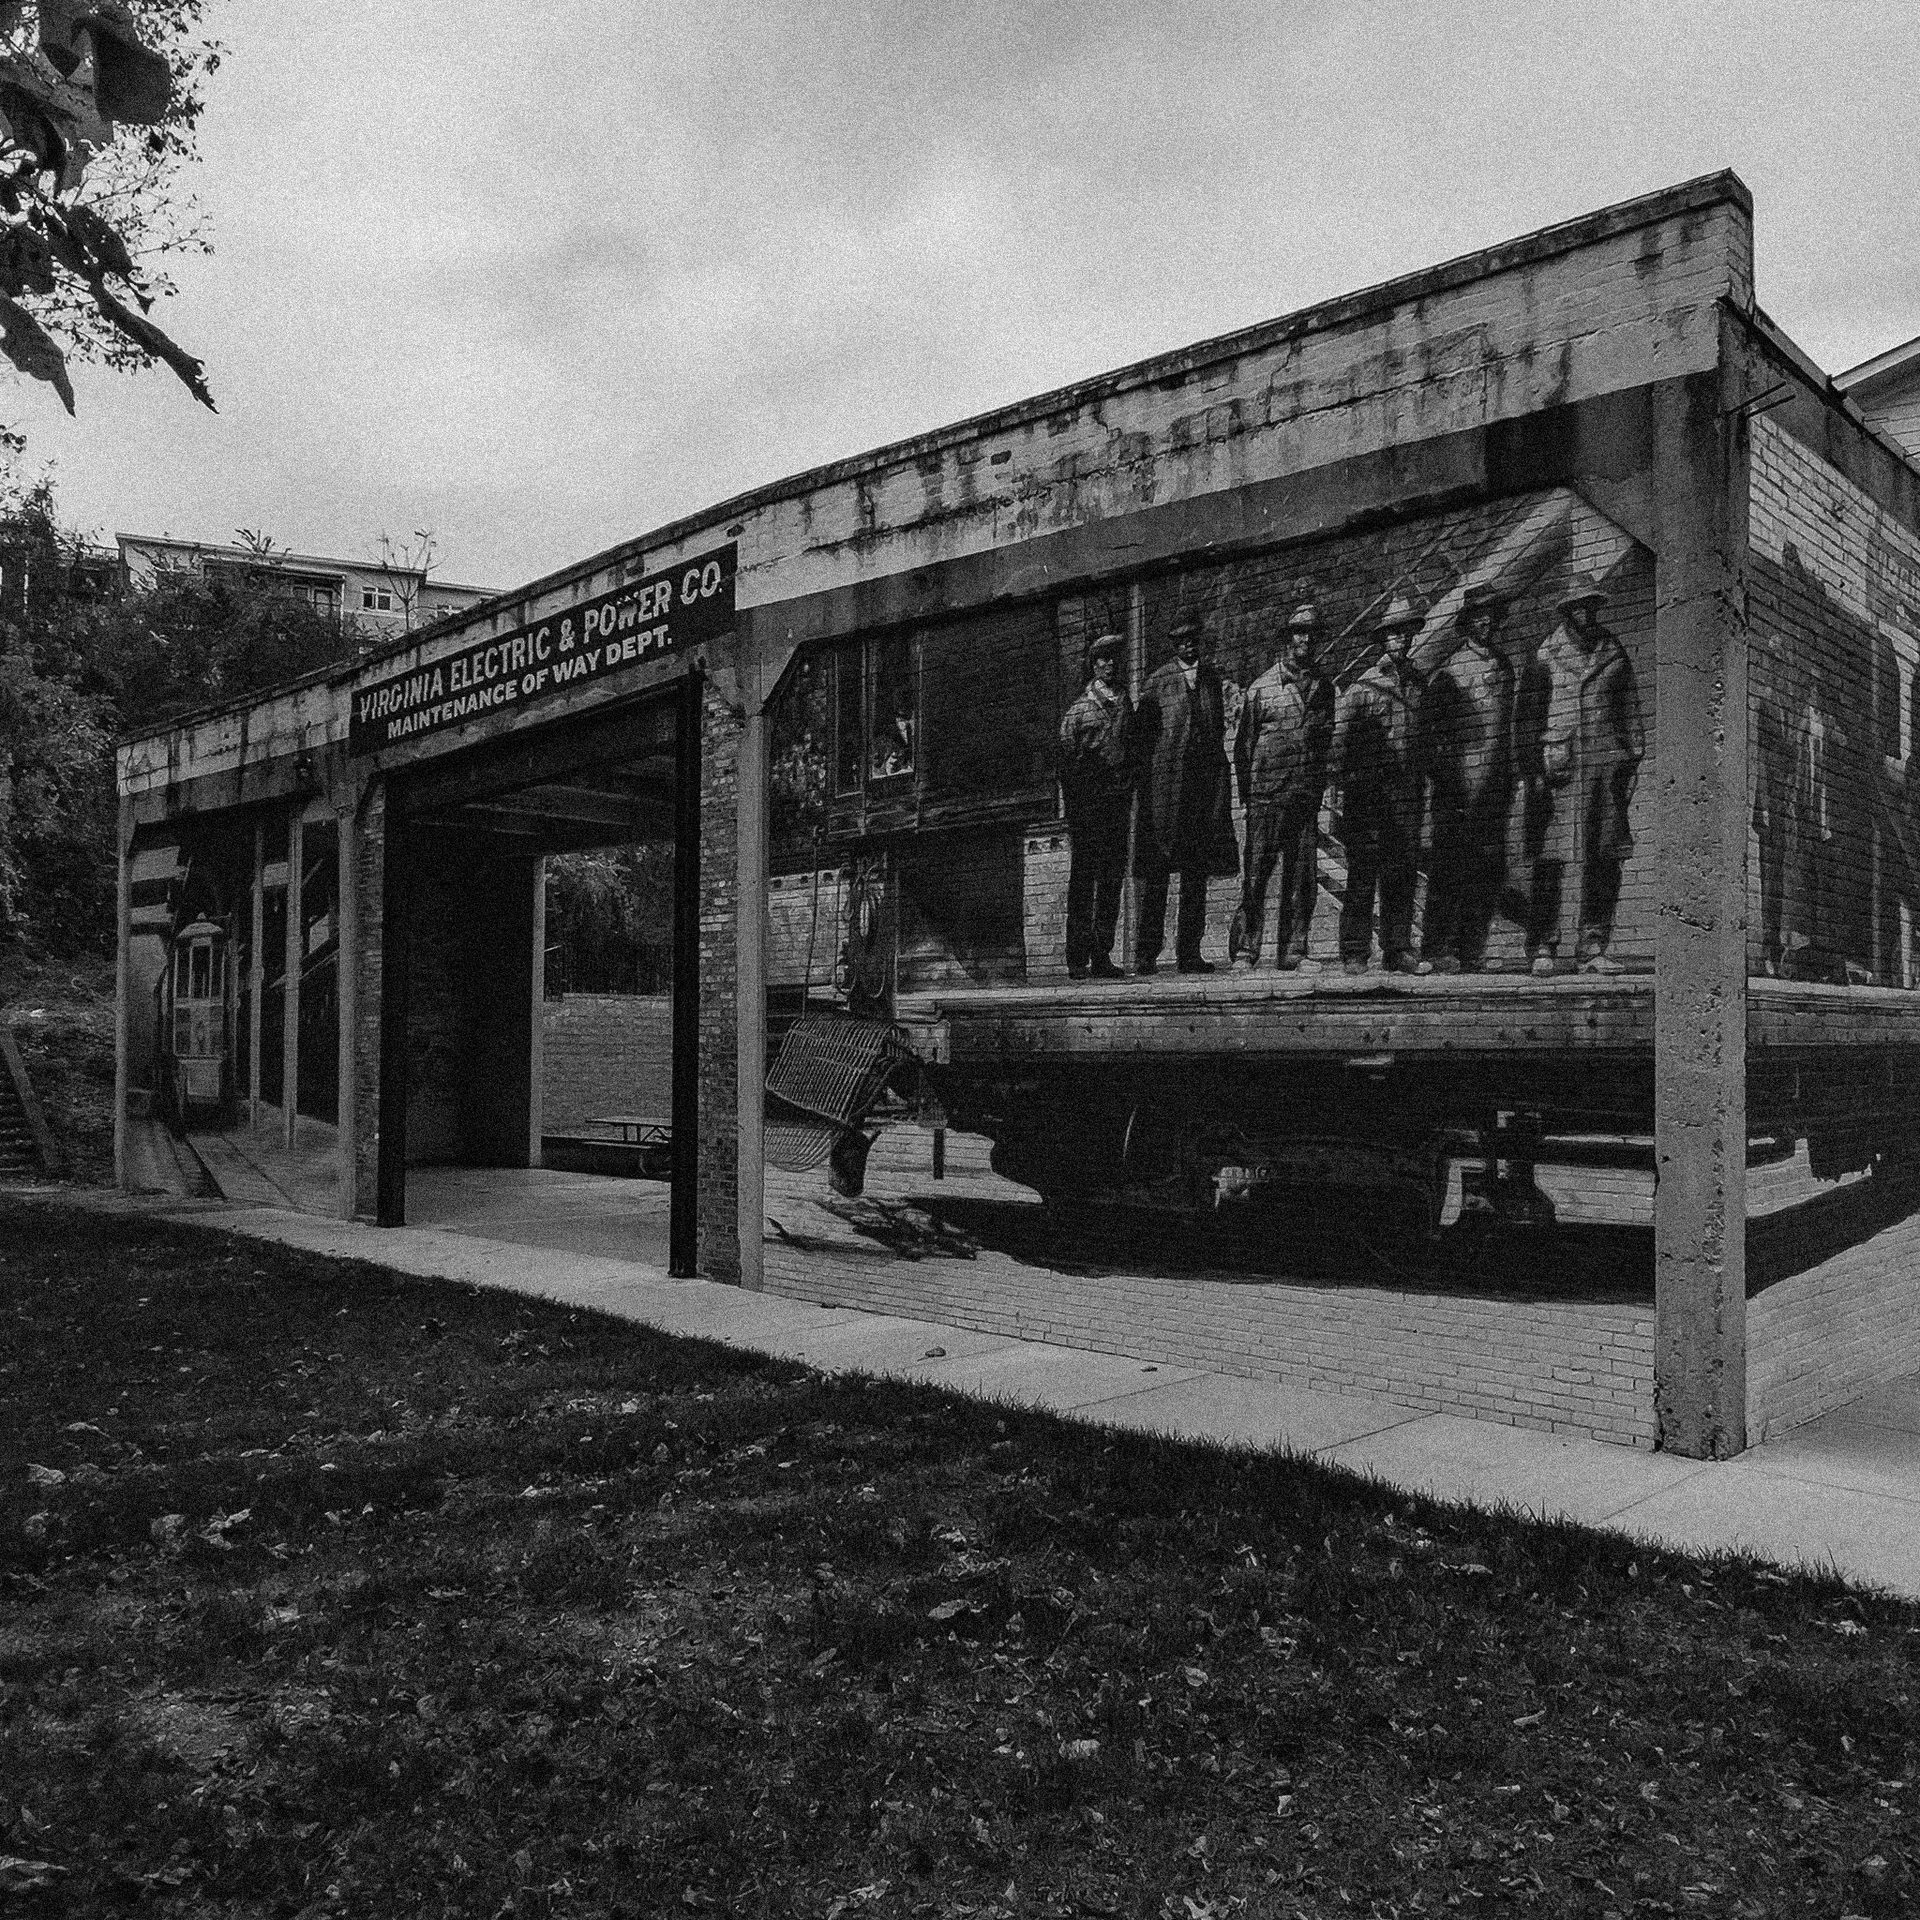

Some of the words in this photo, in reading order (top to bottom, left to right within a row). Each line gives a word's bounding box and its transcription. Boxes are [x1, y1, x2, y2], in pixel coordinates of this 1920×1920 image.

[359, 667, 443, 723] VIRGINIA
[450, 627, 550, 692] ELECTRIC
[559, 619, 575, 653] &
[680, 561, 723, 605] CO.
[387, 679, 518, 739] MAINTENANCE
[521, 668, 549, 694] OF
[552, 648, 601, 684] WAY
[606, 625, 672, 665] DEPT.
